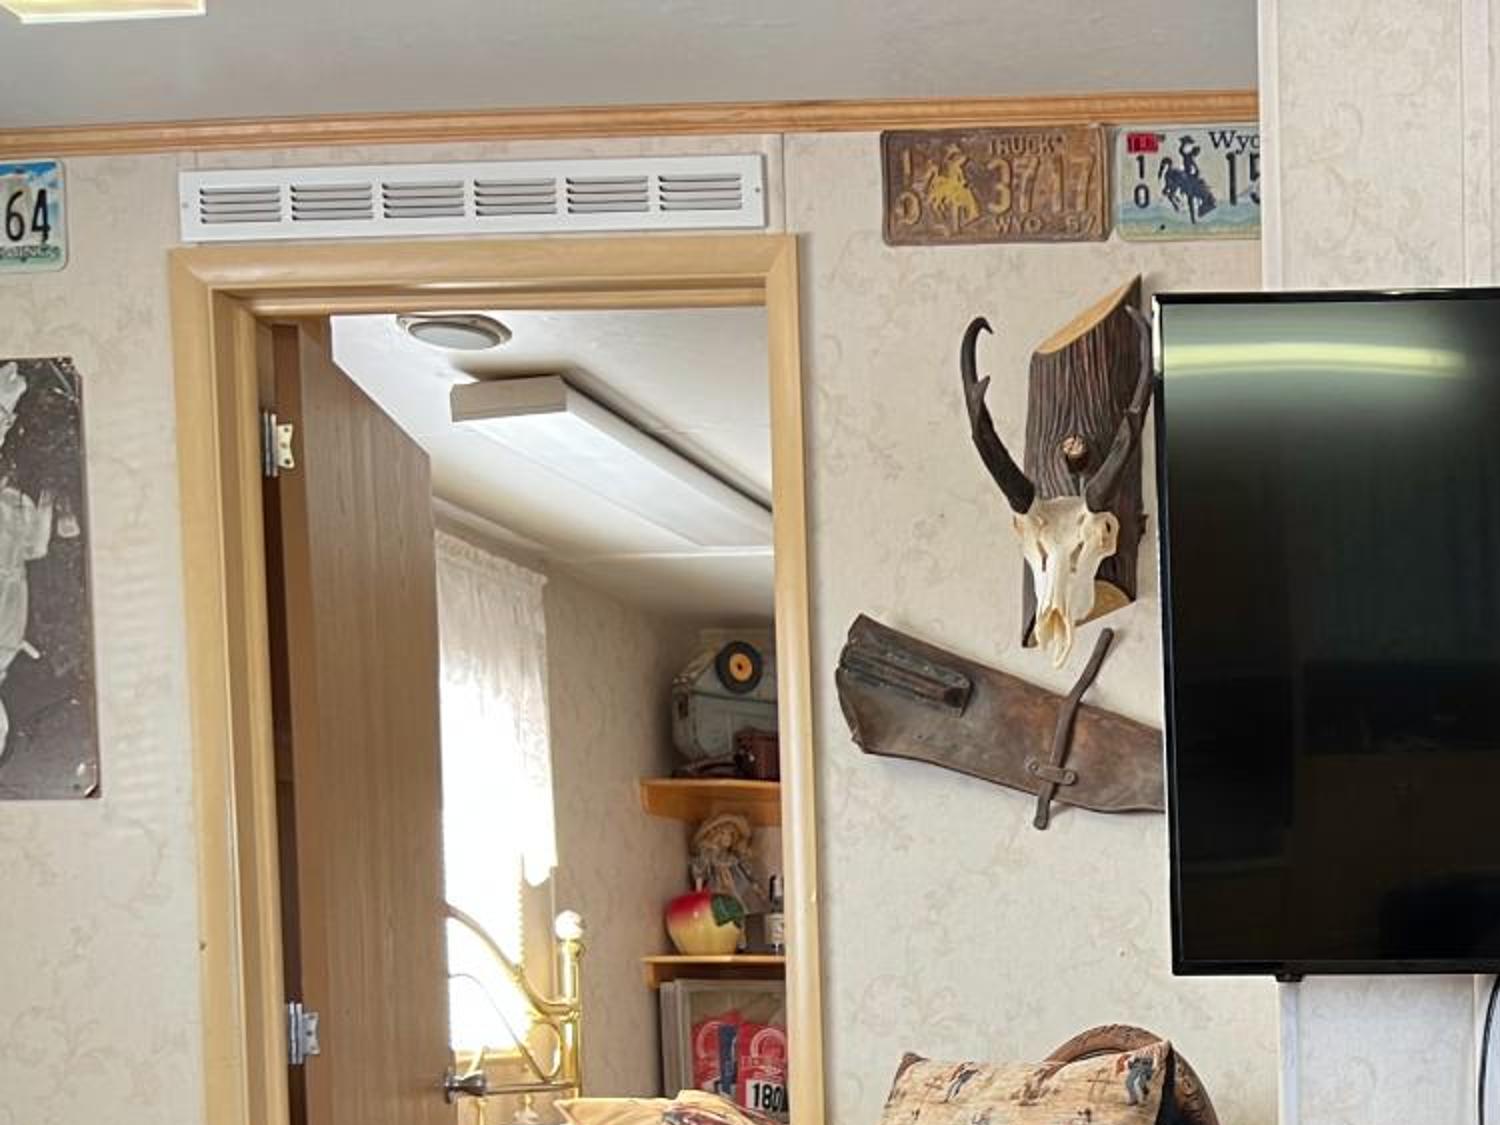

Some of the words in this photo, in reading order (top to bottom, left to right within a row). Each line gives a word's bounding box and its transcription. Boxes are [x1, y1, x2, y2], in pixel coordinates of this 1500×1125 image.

[988, 156, 1097, 215] 3717
[5, 188, 51, 243] 64
[992, 215, 1044, 235] WYO
